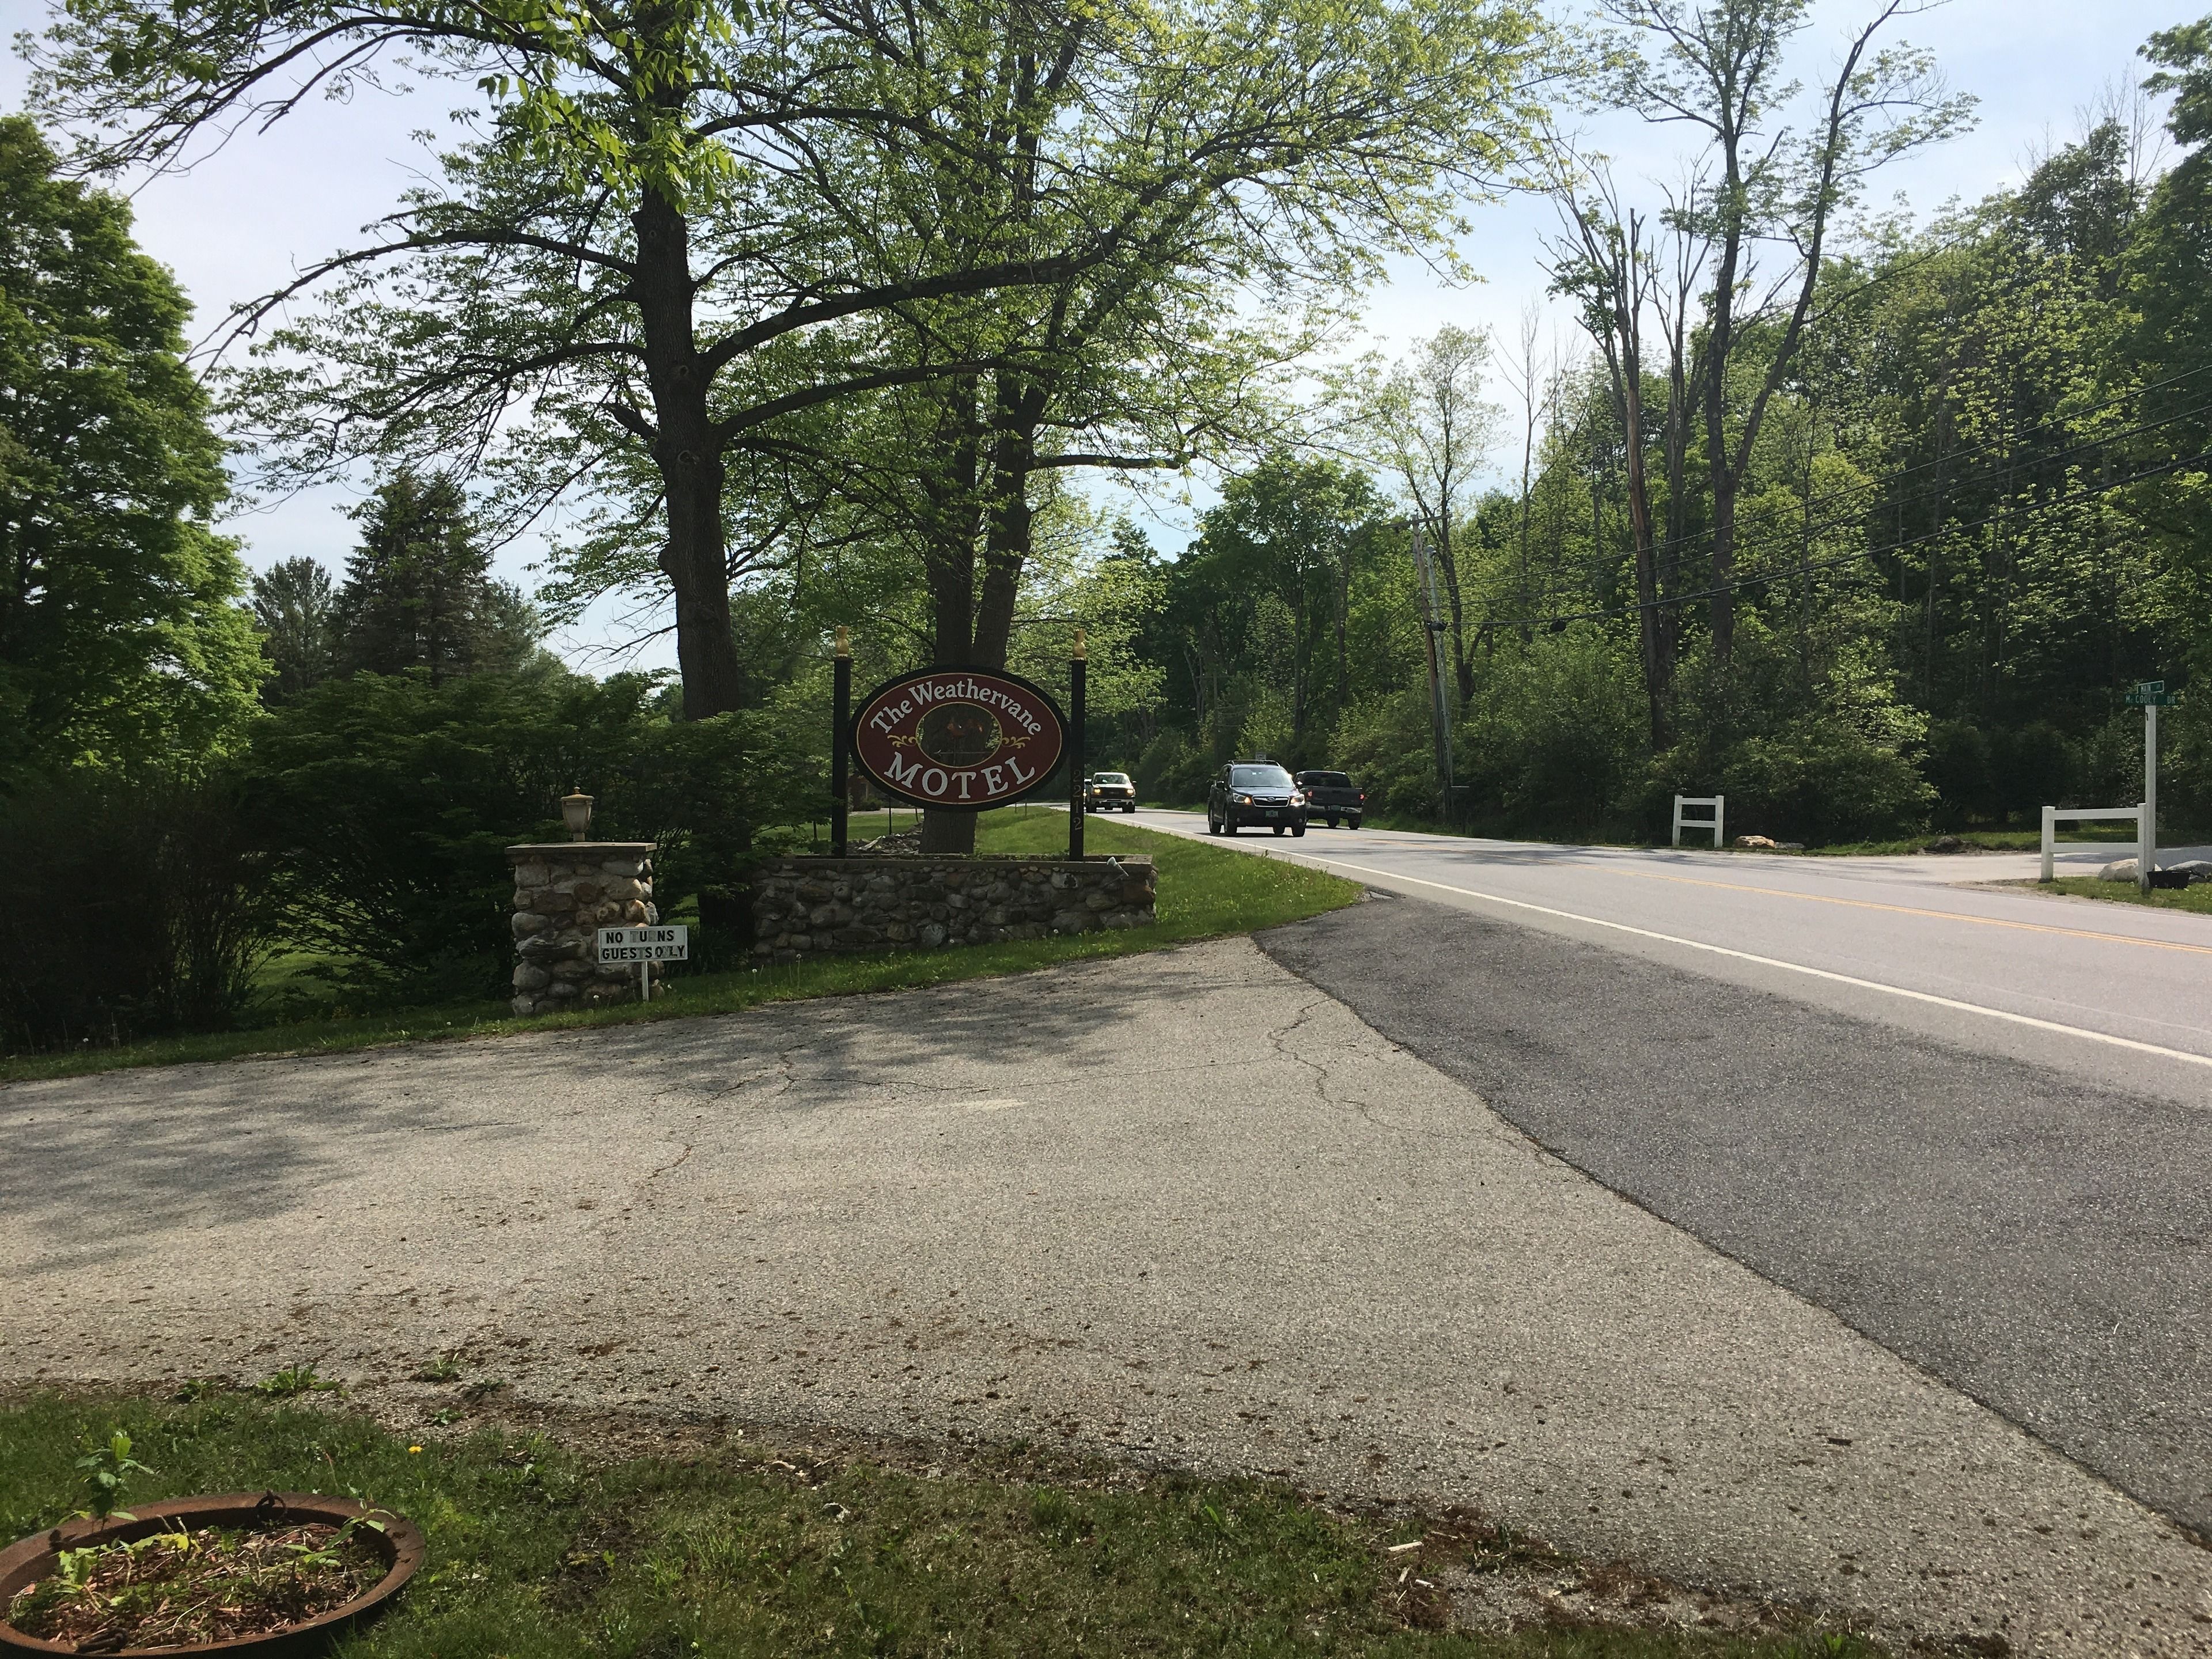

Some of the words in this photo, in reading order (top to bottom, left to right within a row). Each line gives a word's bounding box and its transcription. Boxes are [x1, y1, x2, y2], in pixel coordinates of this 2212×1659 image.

[870, 699, 913, 733] The
[908, 678, 1041, 735] Weathervane
[2167, 696, 2176, 704] DR
[884, 751, 1035, 799] MOTEL
[606, 931, 623, 944] NO
